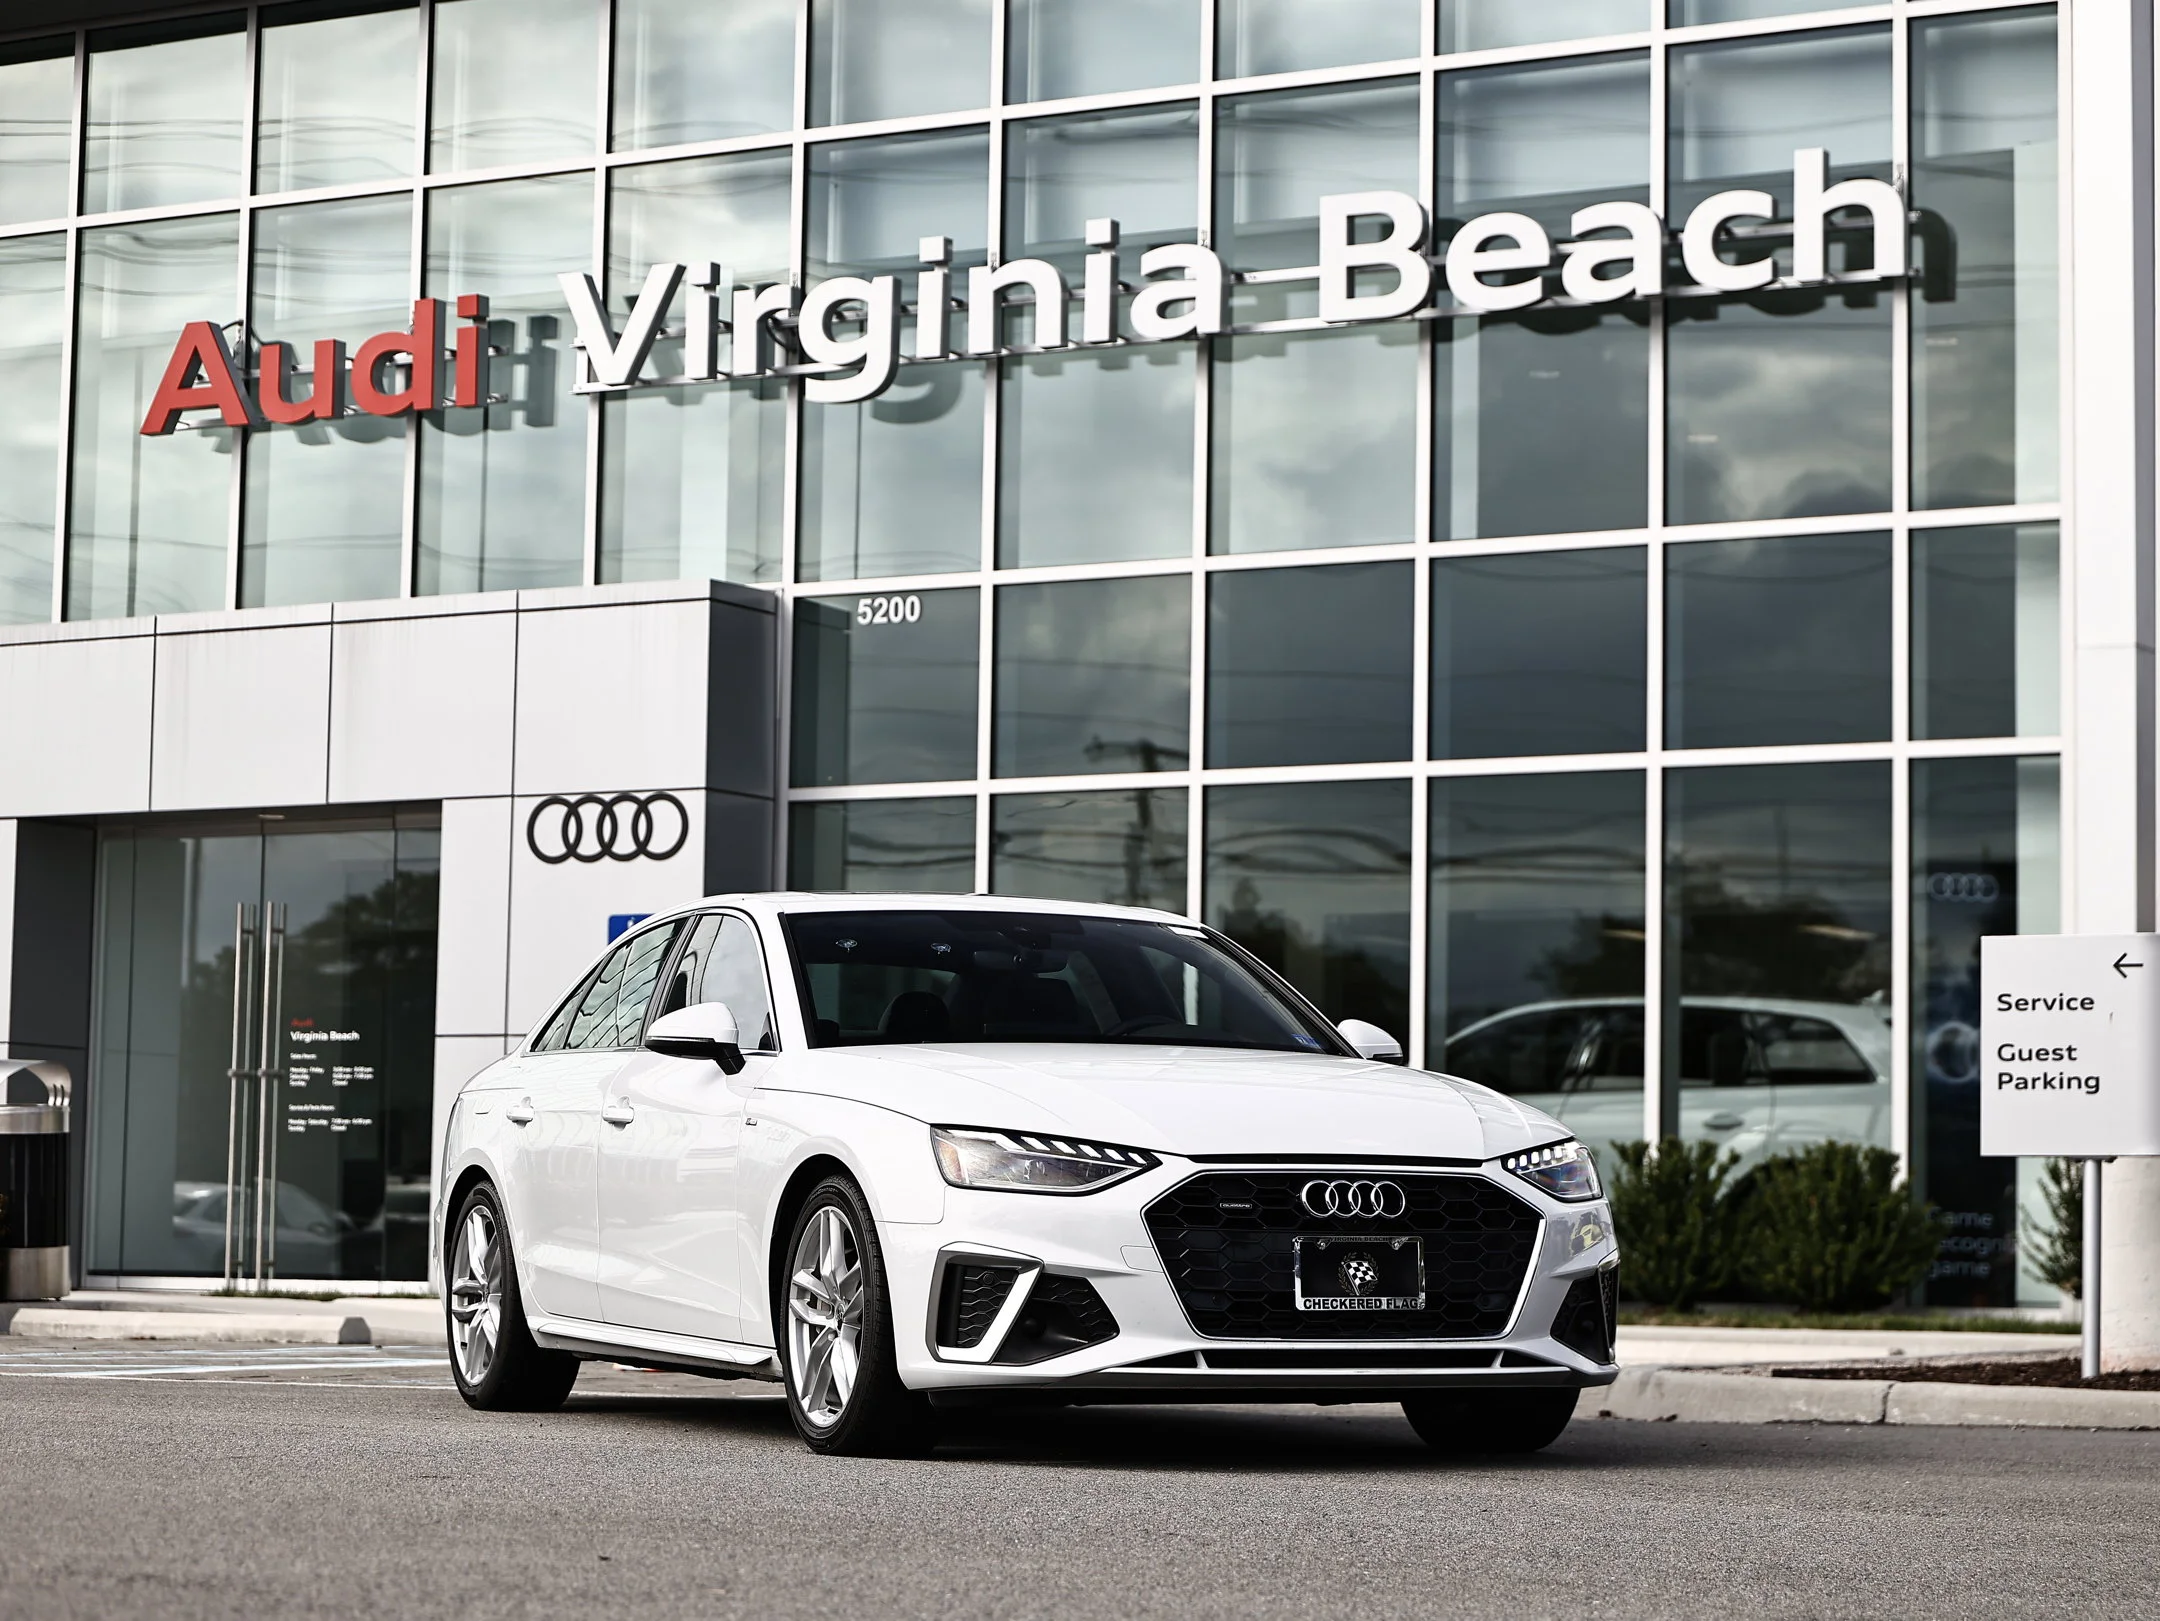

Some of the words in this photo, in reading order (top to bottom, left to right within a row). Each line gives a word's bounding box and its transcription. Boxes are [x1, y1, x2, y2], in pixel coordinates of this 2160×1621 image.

[140, 293, 490, 436] Audi
[557, 218, 1231, 404] Virginia
[1318, 146, 1910, 325] Beach
[857, 595, 922, 625] 5200
[1997, 993, 2095, 1012] Service
[290, 1030, 329, 1043] Virginia
[330, 1030, 360, 1041] Beach
[1997, 1043, 2078, 1062] Guest
[1998, 1072, 2100, 1095] Parking
[1303, 1298, 1383, 1310] CHECKERED
[1385, 1298, 1418, 1309] FLAG
